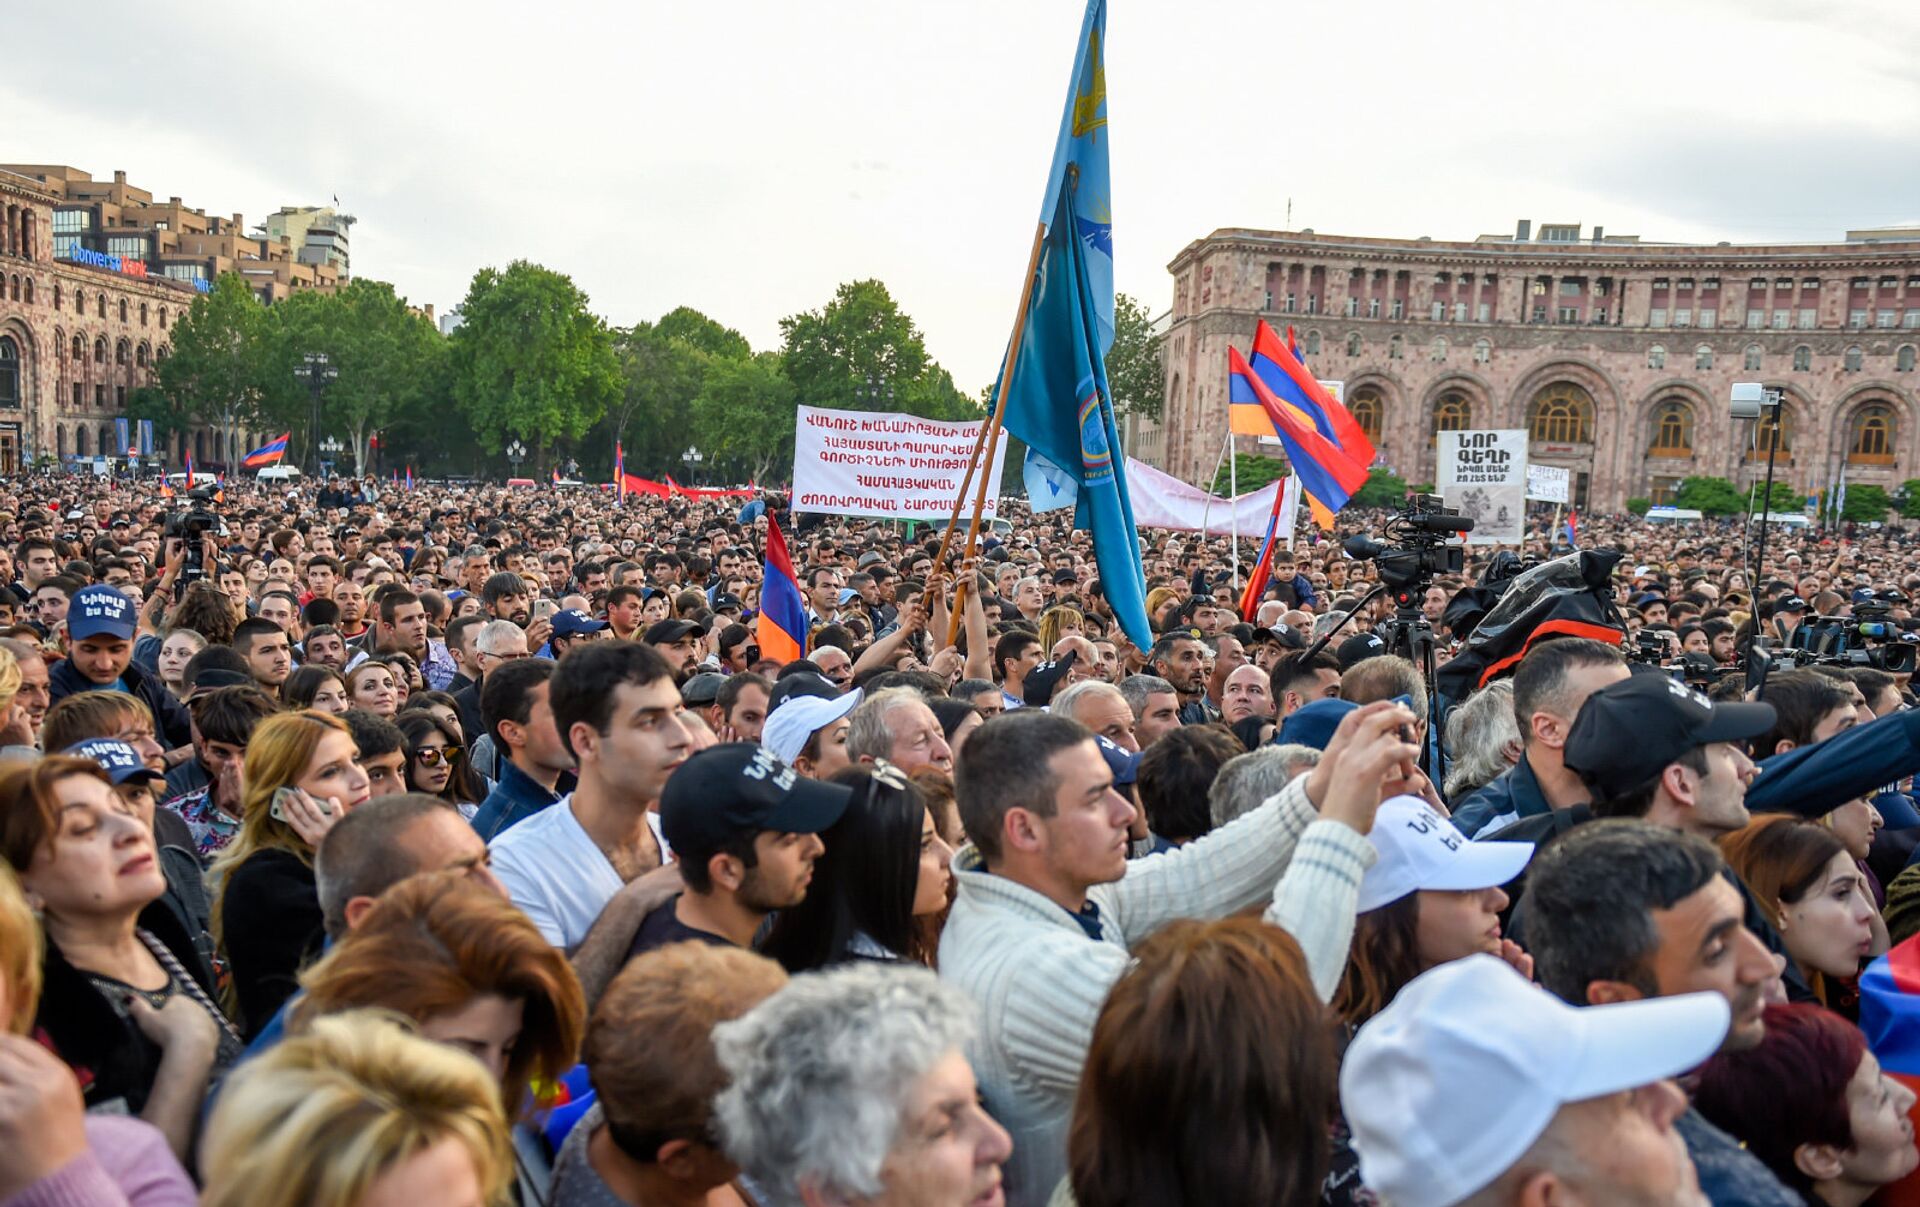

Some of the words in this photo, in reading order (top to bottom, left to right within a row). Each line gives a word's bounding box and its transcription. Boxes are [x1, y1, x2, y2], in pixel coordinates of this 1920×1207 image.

[806, 414, 857, 431] ՎԱՆՈՒՇ
[861, 419, 958, 438] ԽԱՆԱՄԻՐՅԱՆԻ
[824, 436, 900, 451] ՀԱՅԱՍՏԱՆԻ
[902, 443, 987, 455] ՊԱՐԱՐՎԵՍԻ
[1458, 433, 1498, 448] ՆՈՐ
[819, 452, 906, 467] ԳՈՐԾԻՉՆԵՐԻ
[1458, 449, 1511, 464] ԳԵՂԻ
[1457, 465, 1484, 473] ՆԻԿՈԼ
[1486, 465, 1510, 473] ՄԵՆՔ
[857, 475, 956, 490] ՀԱՄԱՀԱՅԿԱԿԱՆ
[1456, 474, 1468, 482] ՔՈ
[1470, 474, 1486, 482] ՀԵՏ
[801, 494, 898, 511] ԺՈՂՈՎՐԴԱԿԱՆ
